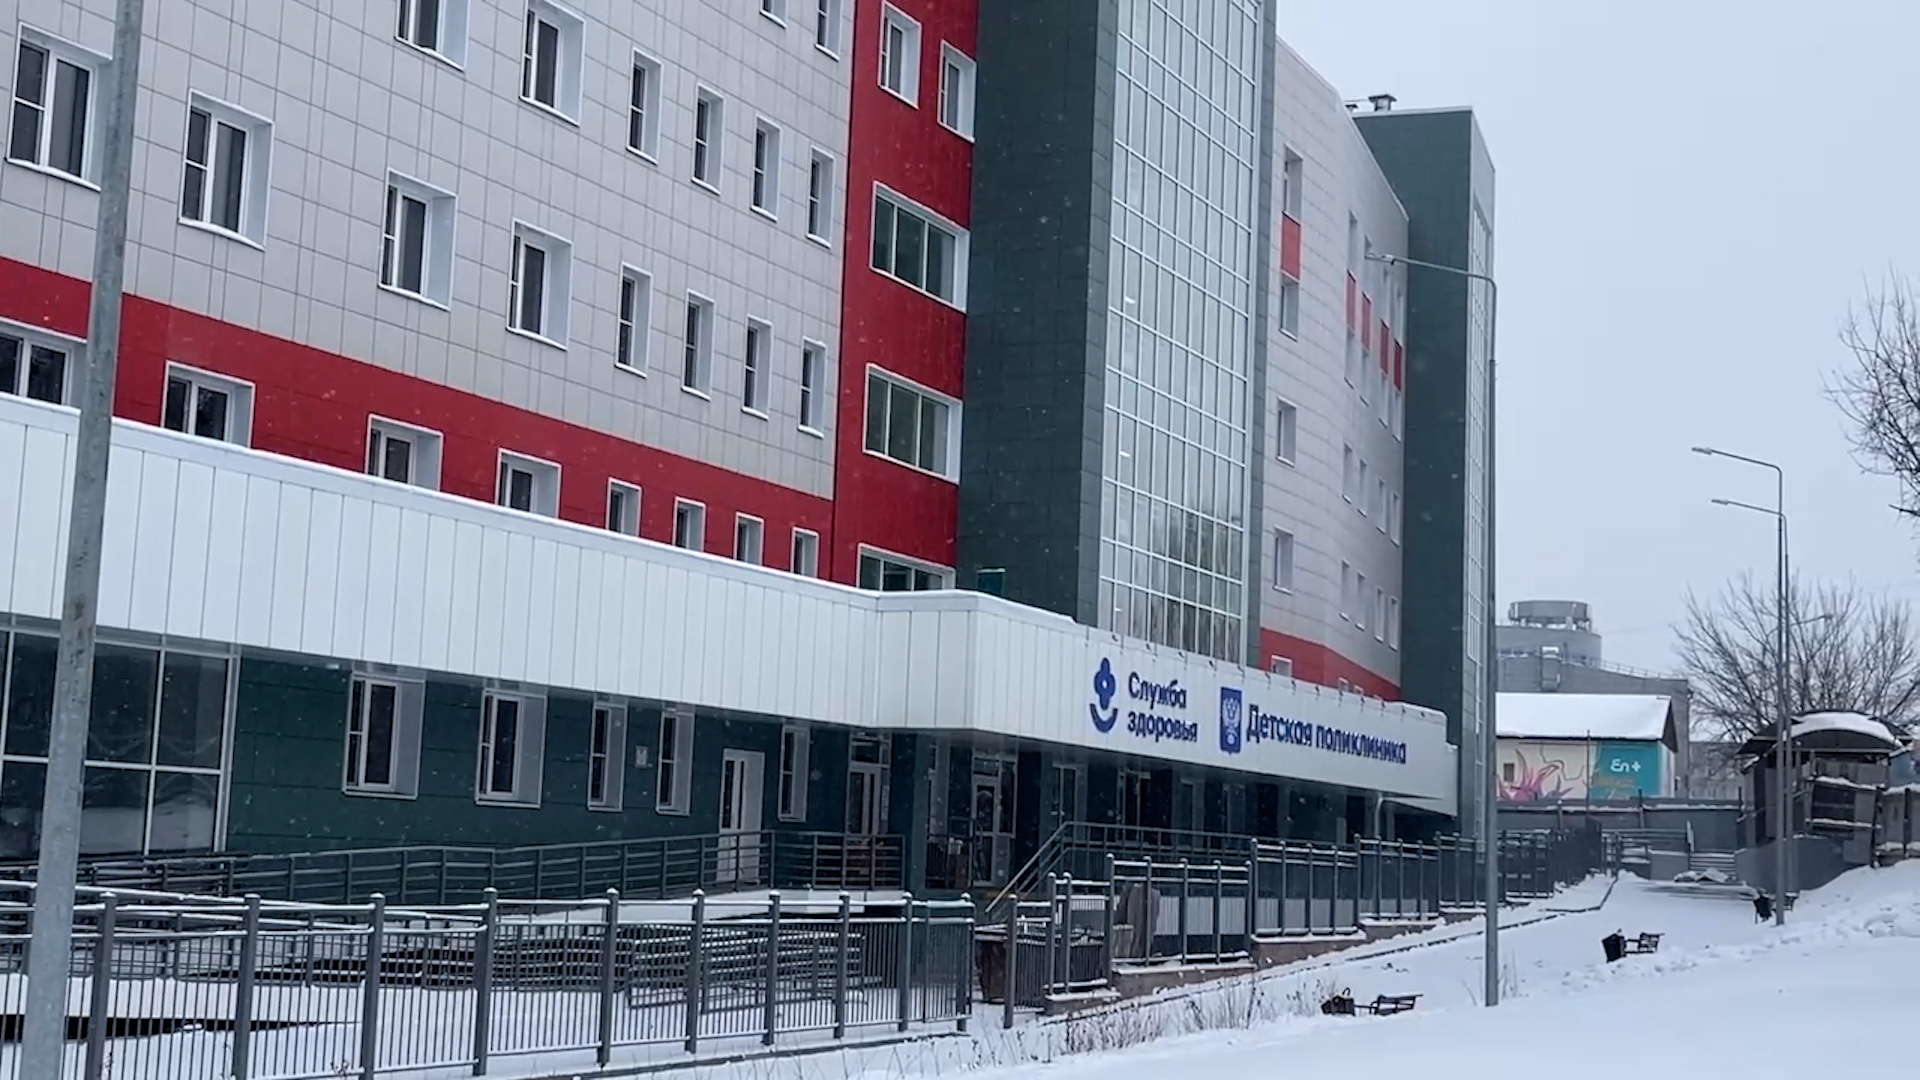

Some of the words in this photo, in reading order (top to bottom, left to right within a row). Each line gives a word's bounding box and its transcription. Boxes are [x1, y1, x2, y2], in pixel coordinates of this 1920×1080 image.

[1128, 671, 1187, 710] Служба
[1127, 711, 1198, 743] здоровья
[1247, 704, 1313, 747] Детская
[1315, 724, 1407, 765] поликлиника
